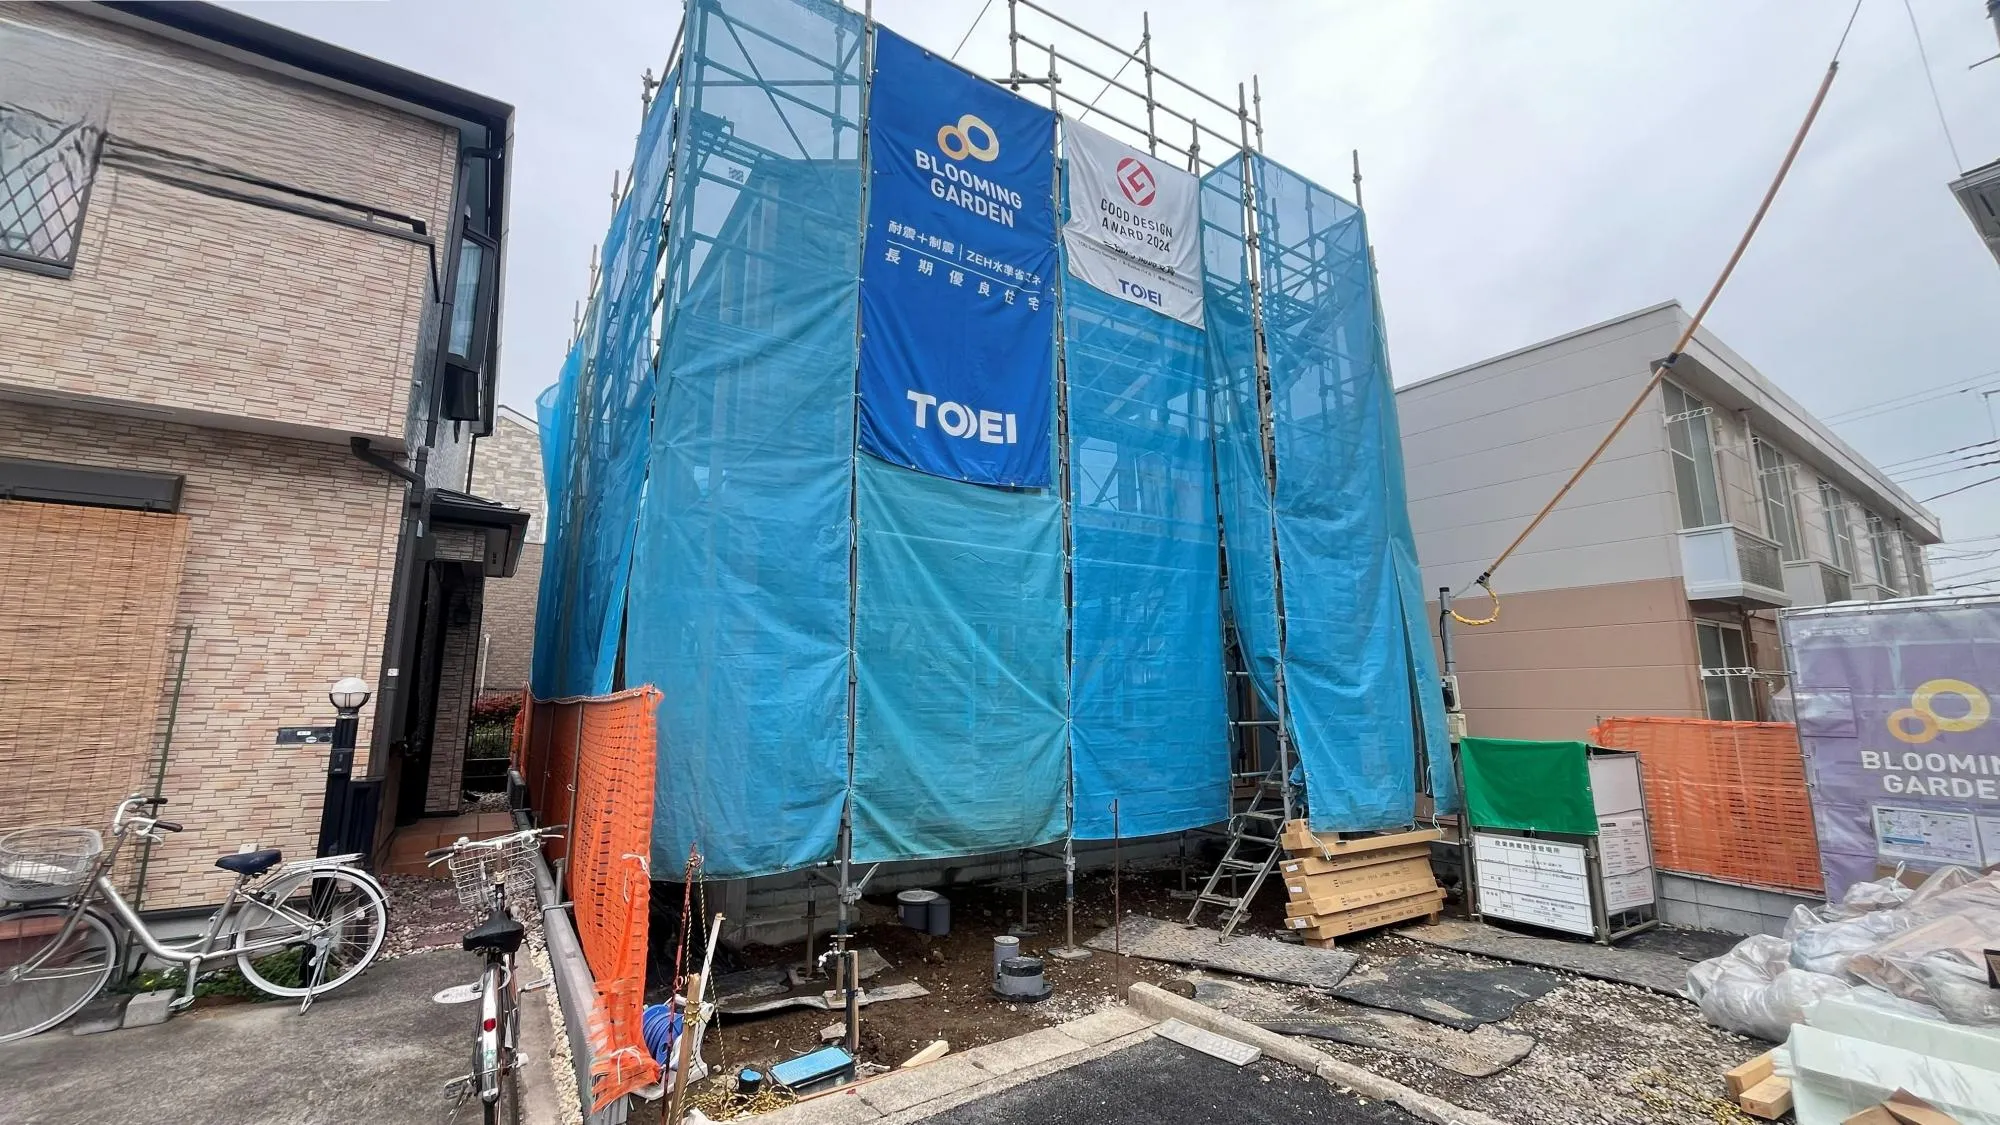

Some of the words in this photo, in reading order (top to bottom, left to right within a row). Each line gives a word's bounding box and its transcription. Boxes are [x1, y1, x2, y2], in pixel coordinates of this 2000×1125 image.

[914, 149, 1022, 210] BLOOMING
[930, 177, 1014, 229] GARDEN
[1101, 198, 1130, 222] GOOD
[1133, 215, 1174, 238] DESIGN
[1101, 217, 1144, 241] AWARD
[1147, 233, 1171, 253] 2024
[885, 248, 1039, 311] 長期優良住宅
[1118, 279, 1162, 307] TOEI
[907, 390, 1017, 444] TOEI
[1883, 774, 2000, 800] GARDE
